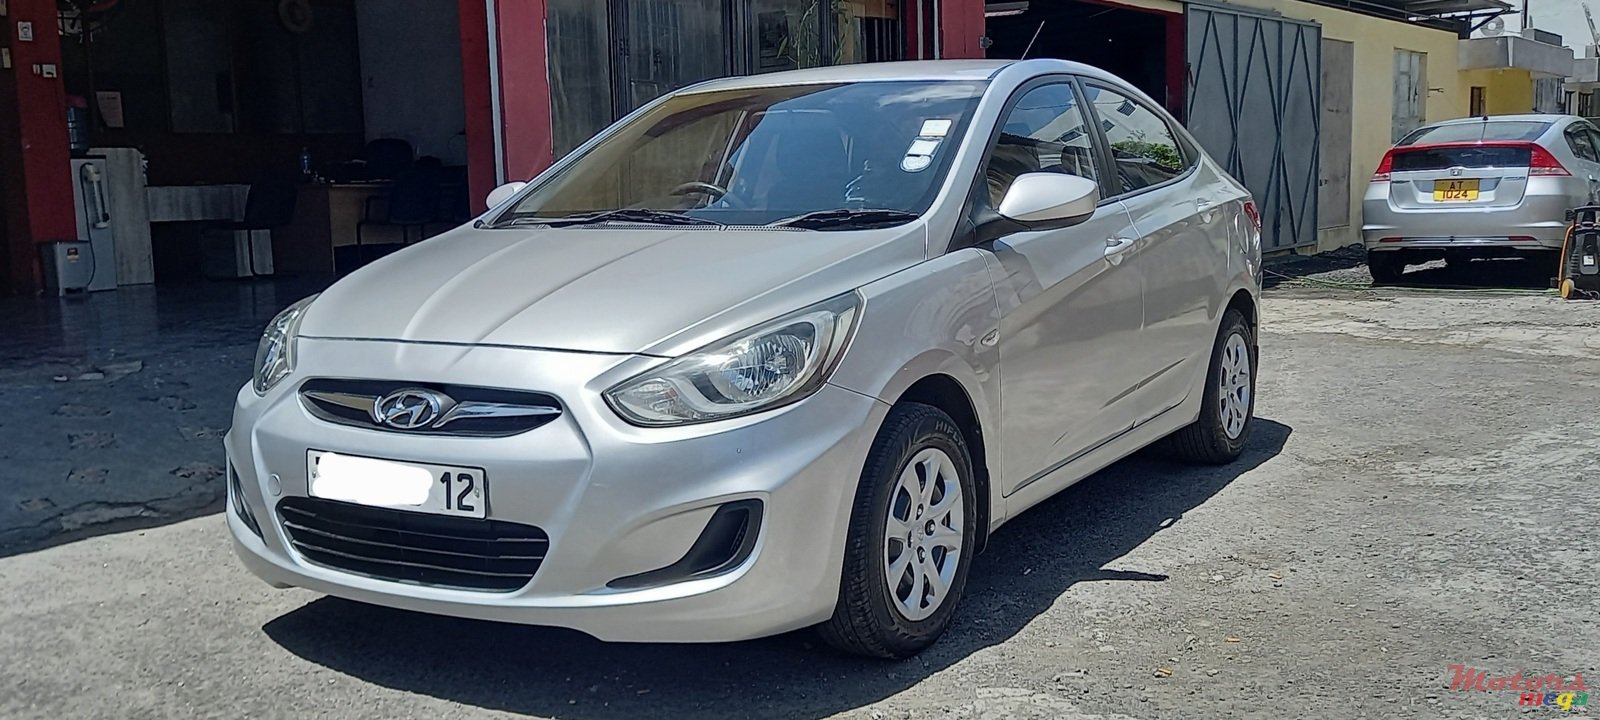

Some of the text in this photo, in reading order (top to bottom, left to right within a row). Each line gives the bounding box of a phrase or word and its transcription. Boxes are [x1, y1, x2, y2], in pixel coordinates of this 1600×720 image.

[1449, 181, 1464, 190] AT
[1442, 190, 1468, 199] 1024
[935, 420, 964, 446] HIFLY
[440, 471, 475, 512] 12
